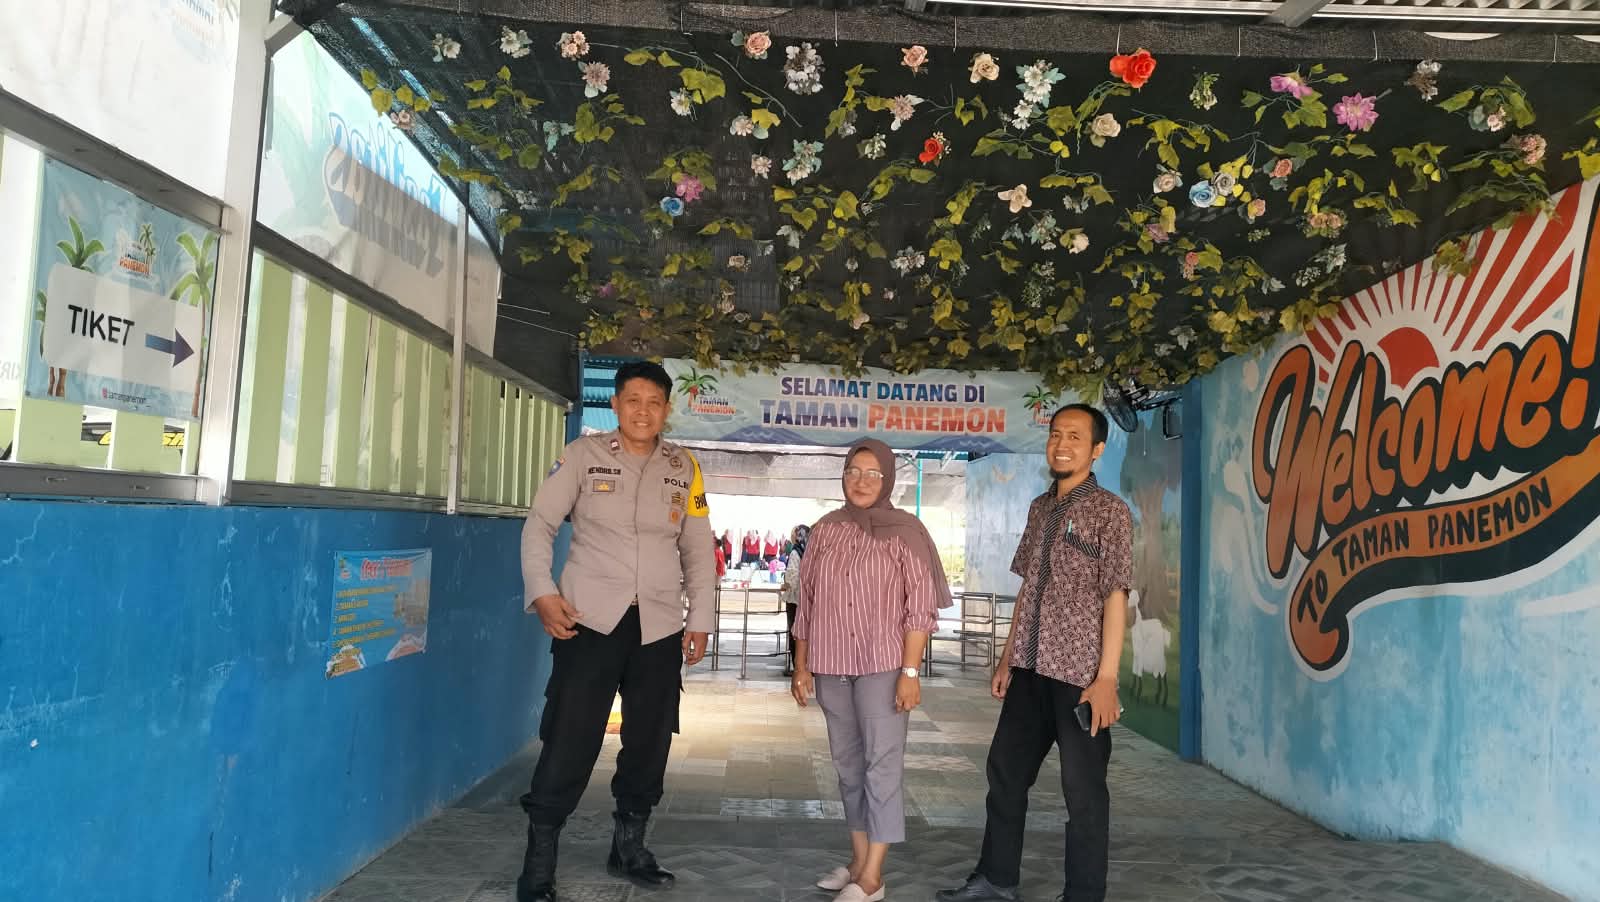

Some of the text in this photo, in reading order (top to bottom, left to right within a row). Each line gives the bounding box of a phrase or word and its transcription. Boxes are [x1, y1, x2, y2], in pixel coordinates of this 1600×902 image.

[68, 304, 135, 346] TIKET
[781, 376, 985, 403] SELAMAT DATANG DI
[1252, 184, 1600, 580] Welcome!
[760, 400, 1006, 433] TAMAN PANEMON
[1299, 477, 1553, 624] TO TAMAN PANEMON
